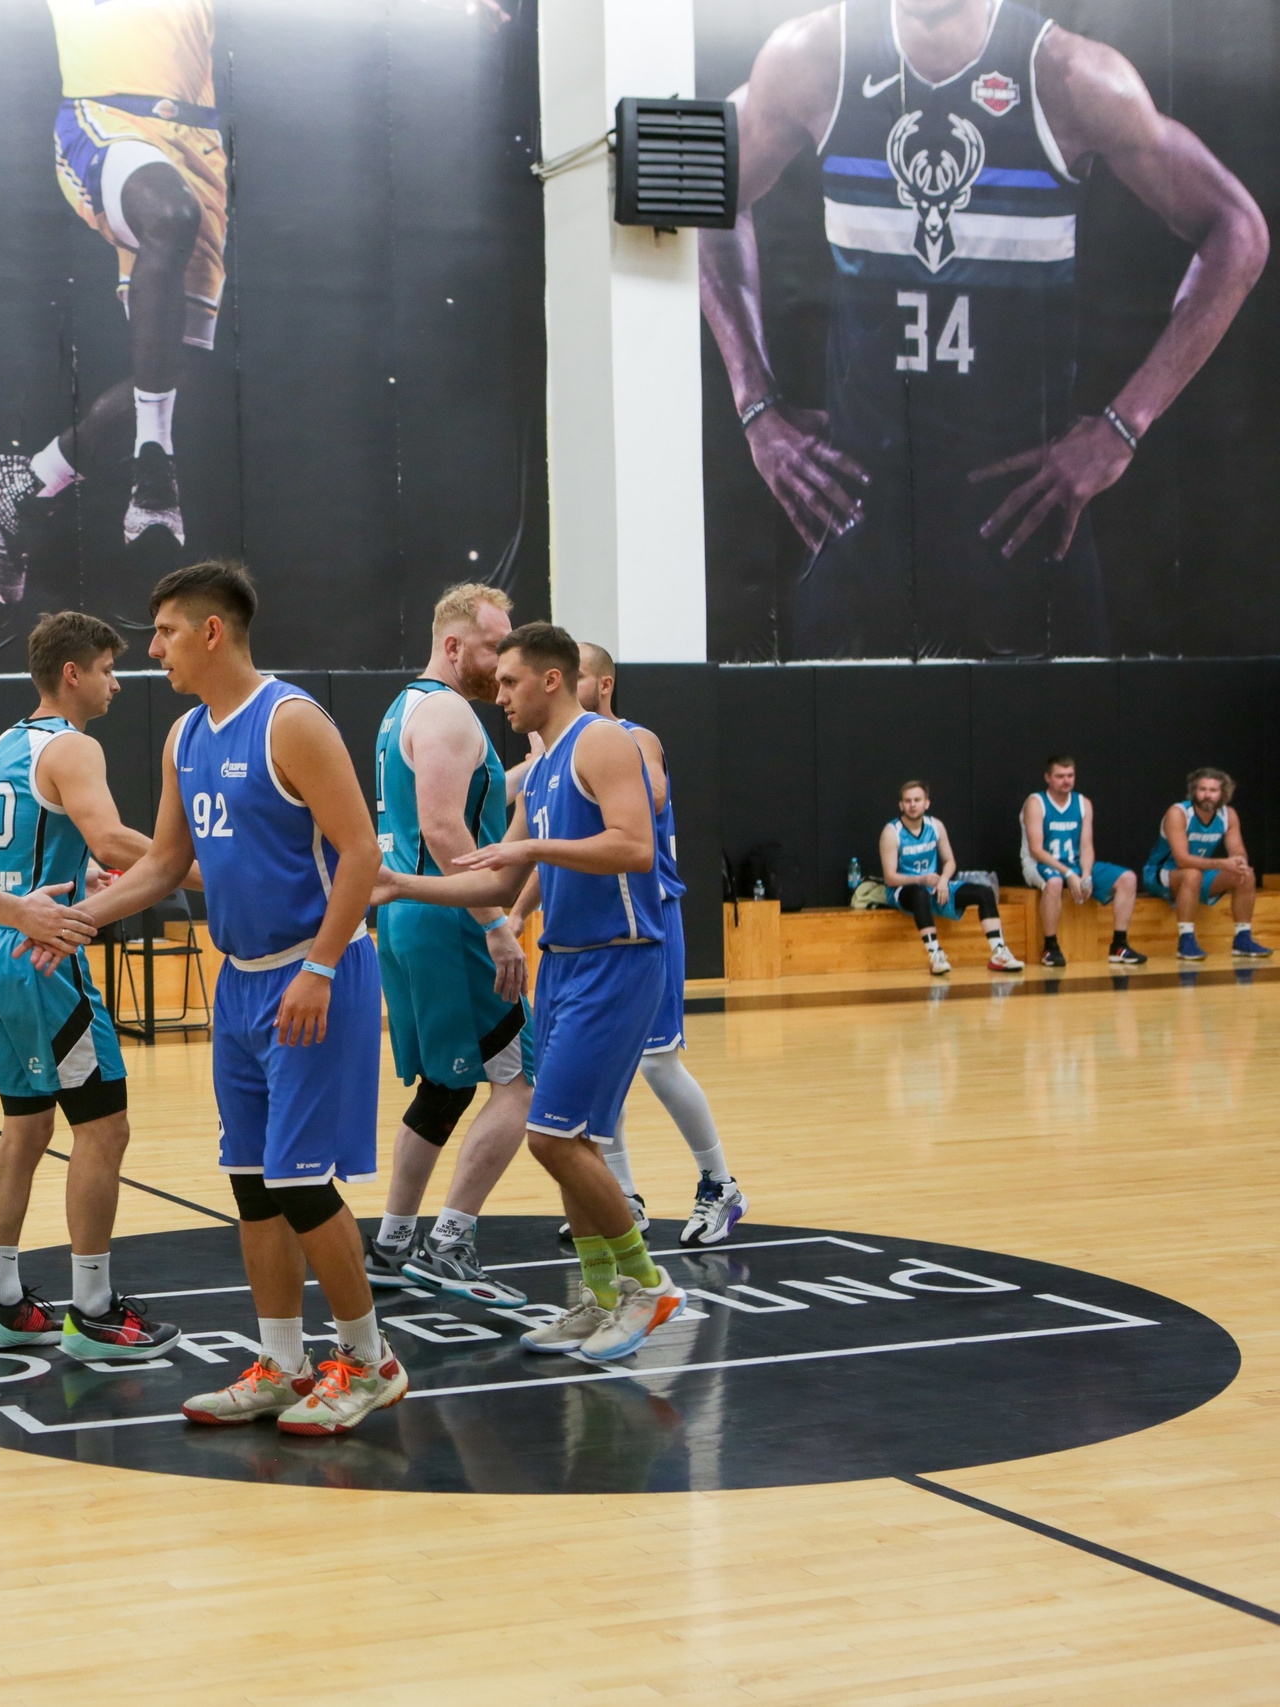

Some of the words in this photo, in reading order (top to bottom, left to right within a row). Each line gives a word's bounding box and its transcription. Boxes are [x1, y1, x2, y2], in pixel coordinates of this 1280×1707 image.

[896, 291, 975, 373] 34
[192, 792, 233, 838] 92
[912, 858, 930, 873] 33
[1049, 838, 1075, 865] 11
